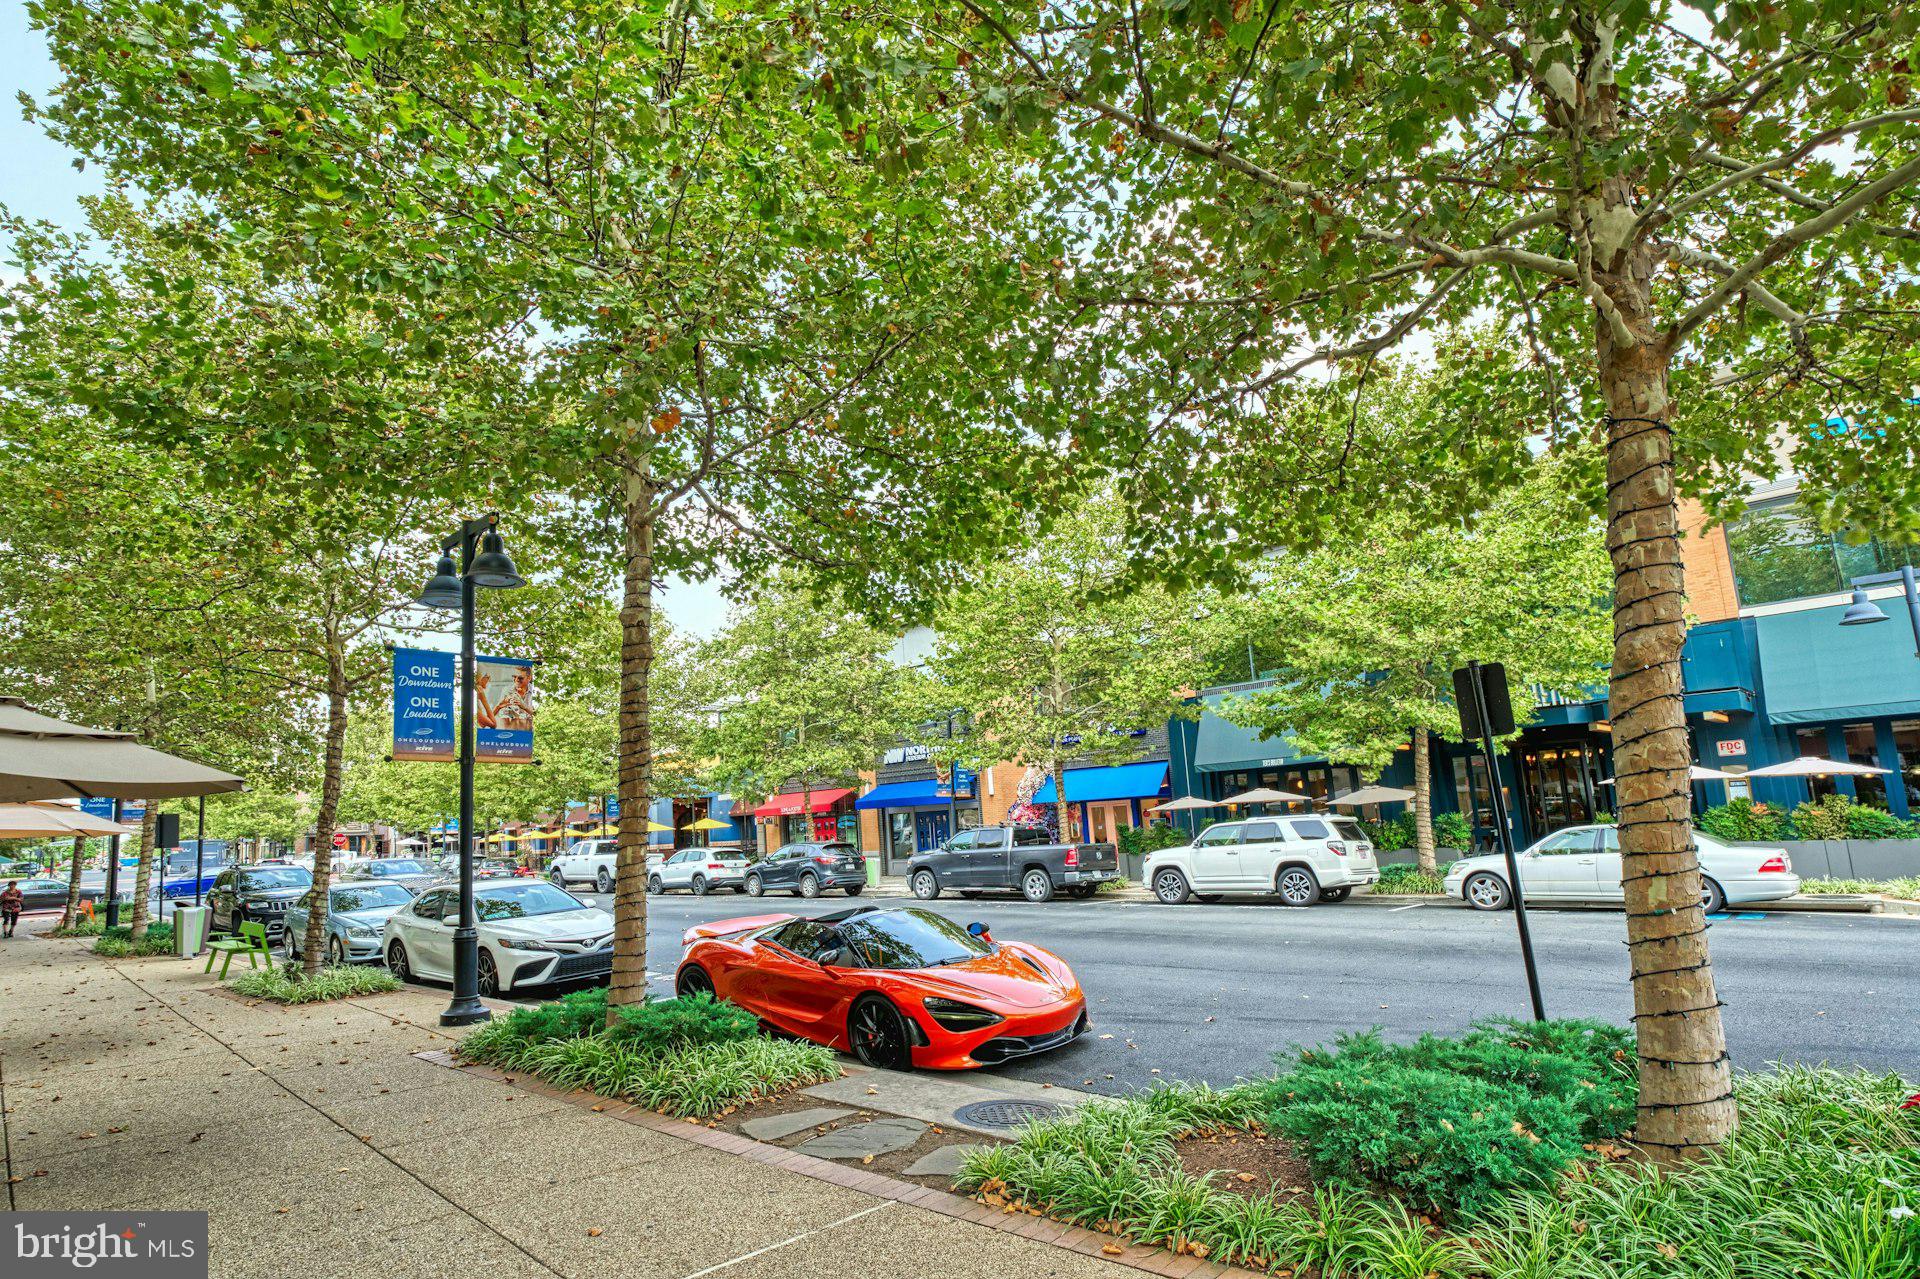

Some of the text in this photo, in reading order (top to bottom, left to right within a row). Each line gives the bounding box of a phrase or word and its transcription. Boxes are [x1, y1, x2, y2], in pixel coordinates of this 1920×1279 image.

[410, 666, 439, 677] ONE
[398, 675, 453, 690] Downtown
[410, 697, 440, 708] ONE
[403, 707, 448, 720] Loudoun
[1719, 741, 1742, 751] FDC
